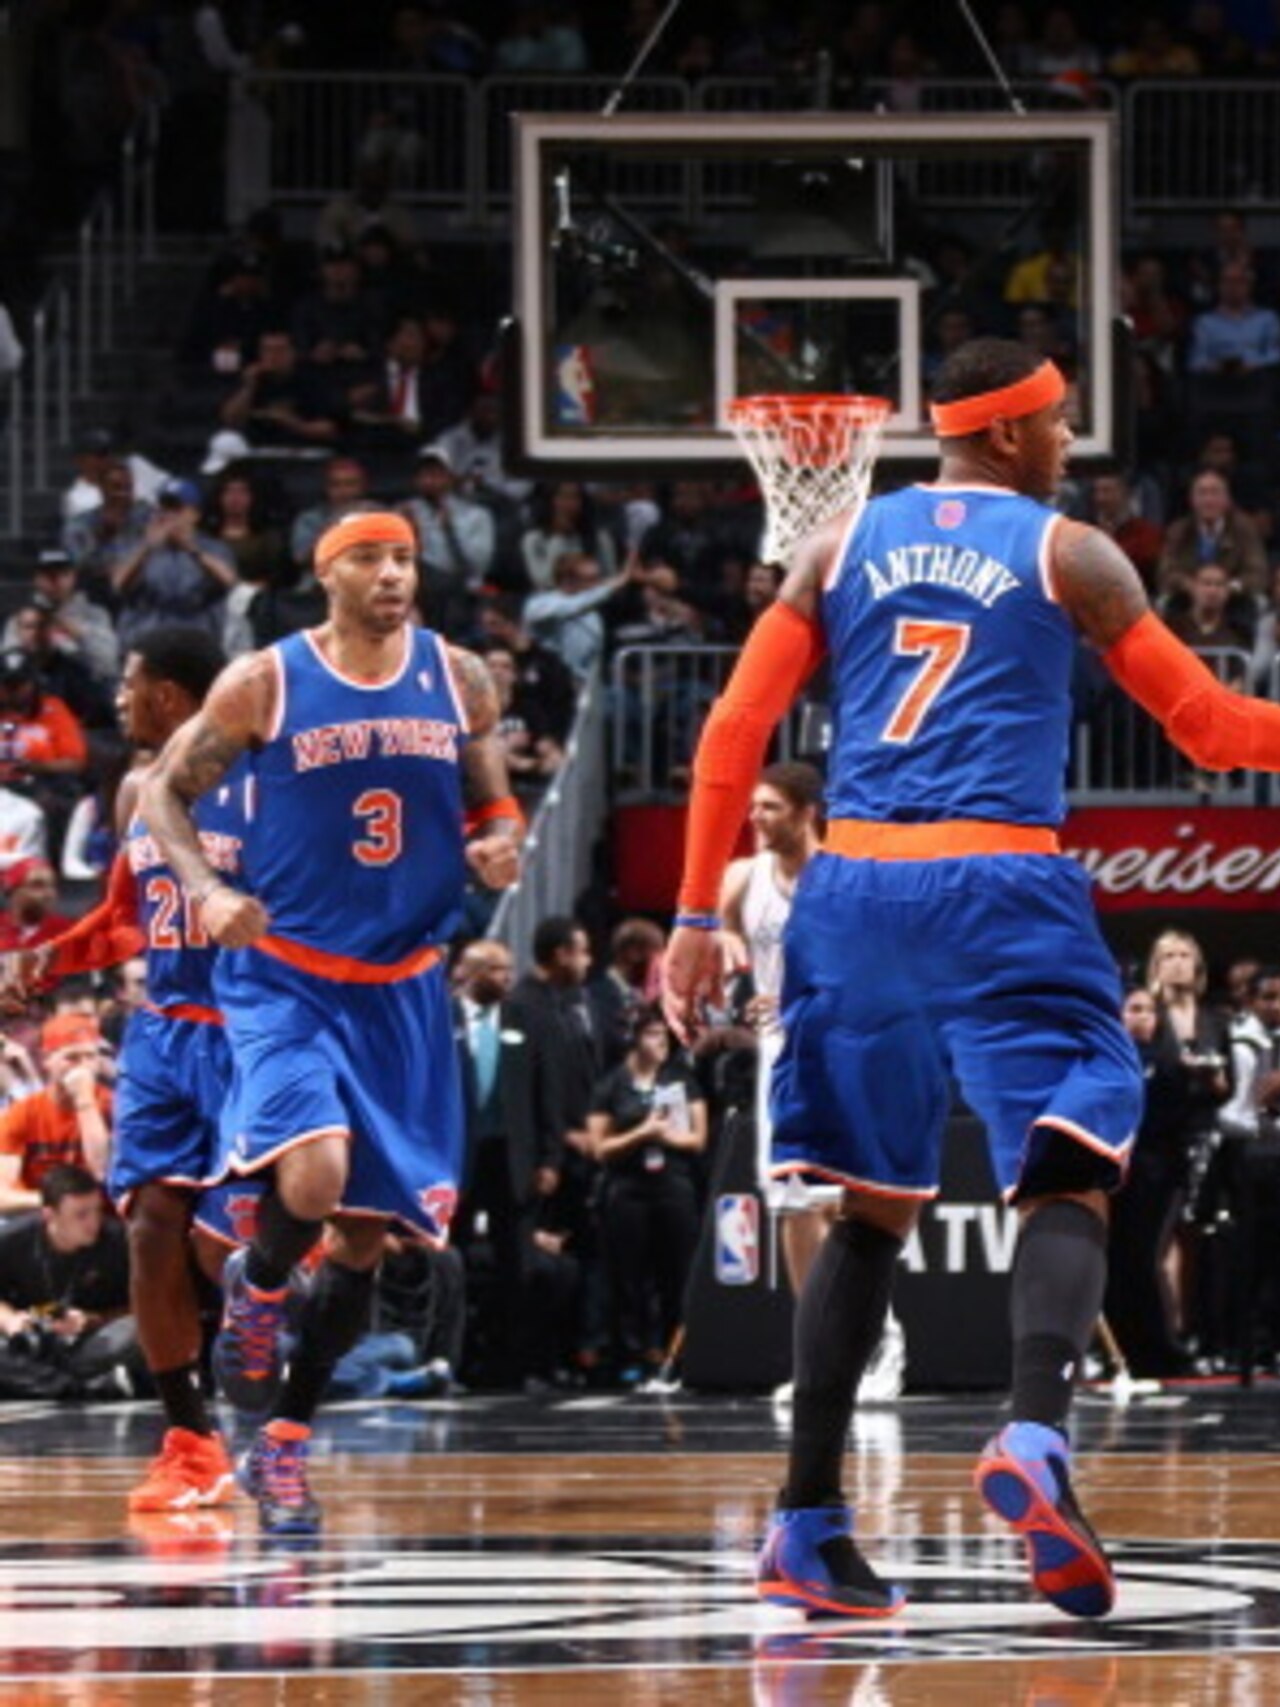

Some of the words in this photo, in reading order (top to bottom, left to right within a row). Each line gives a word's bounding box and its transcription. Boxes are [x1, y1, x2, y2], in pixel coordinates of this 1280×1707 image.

[863, 541, 1022, 608] ANTHONY
[879, 616, 972, 744] 7
[292, 721, 373, 773] NEW
[373, 717, 458, 765] YORK
[352, 787, 403, 867] 3
[145, 873, 208, 949] 21
[934, 1203, 1019, 1273] TV
